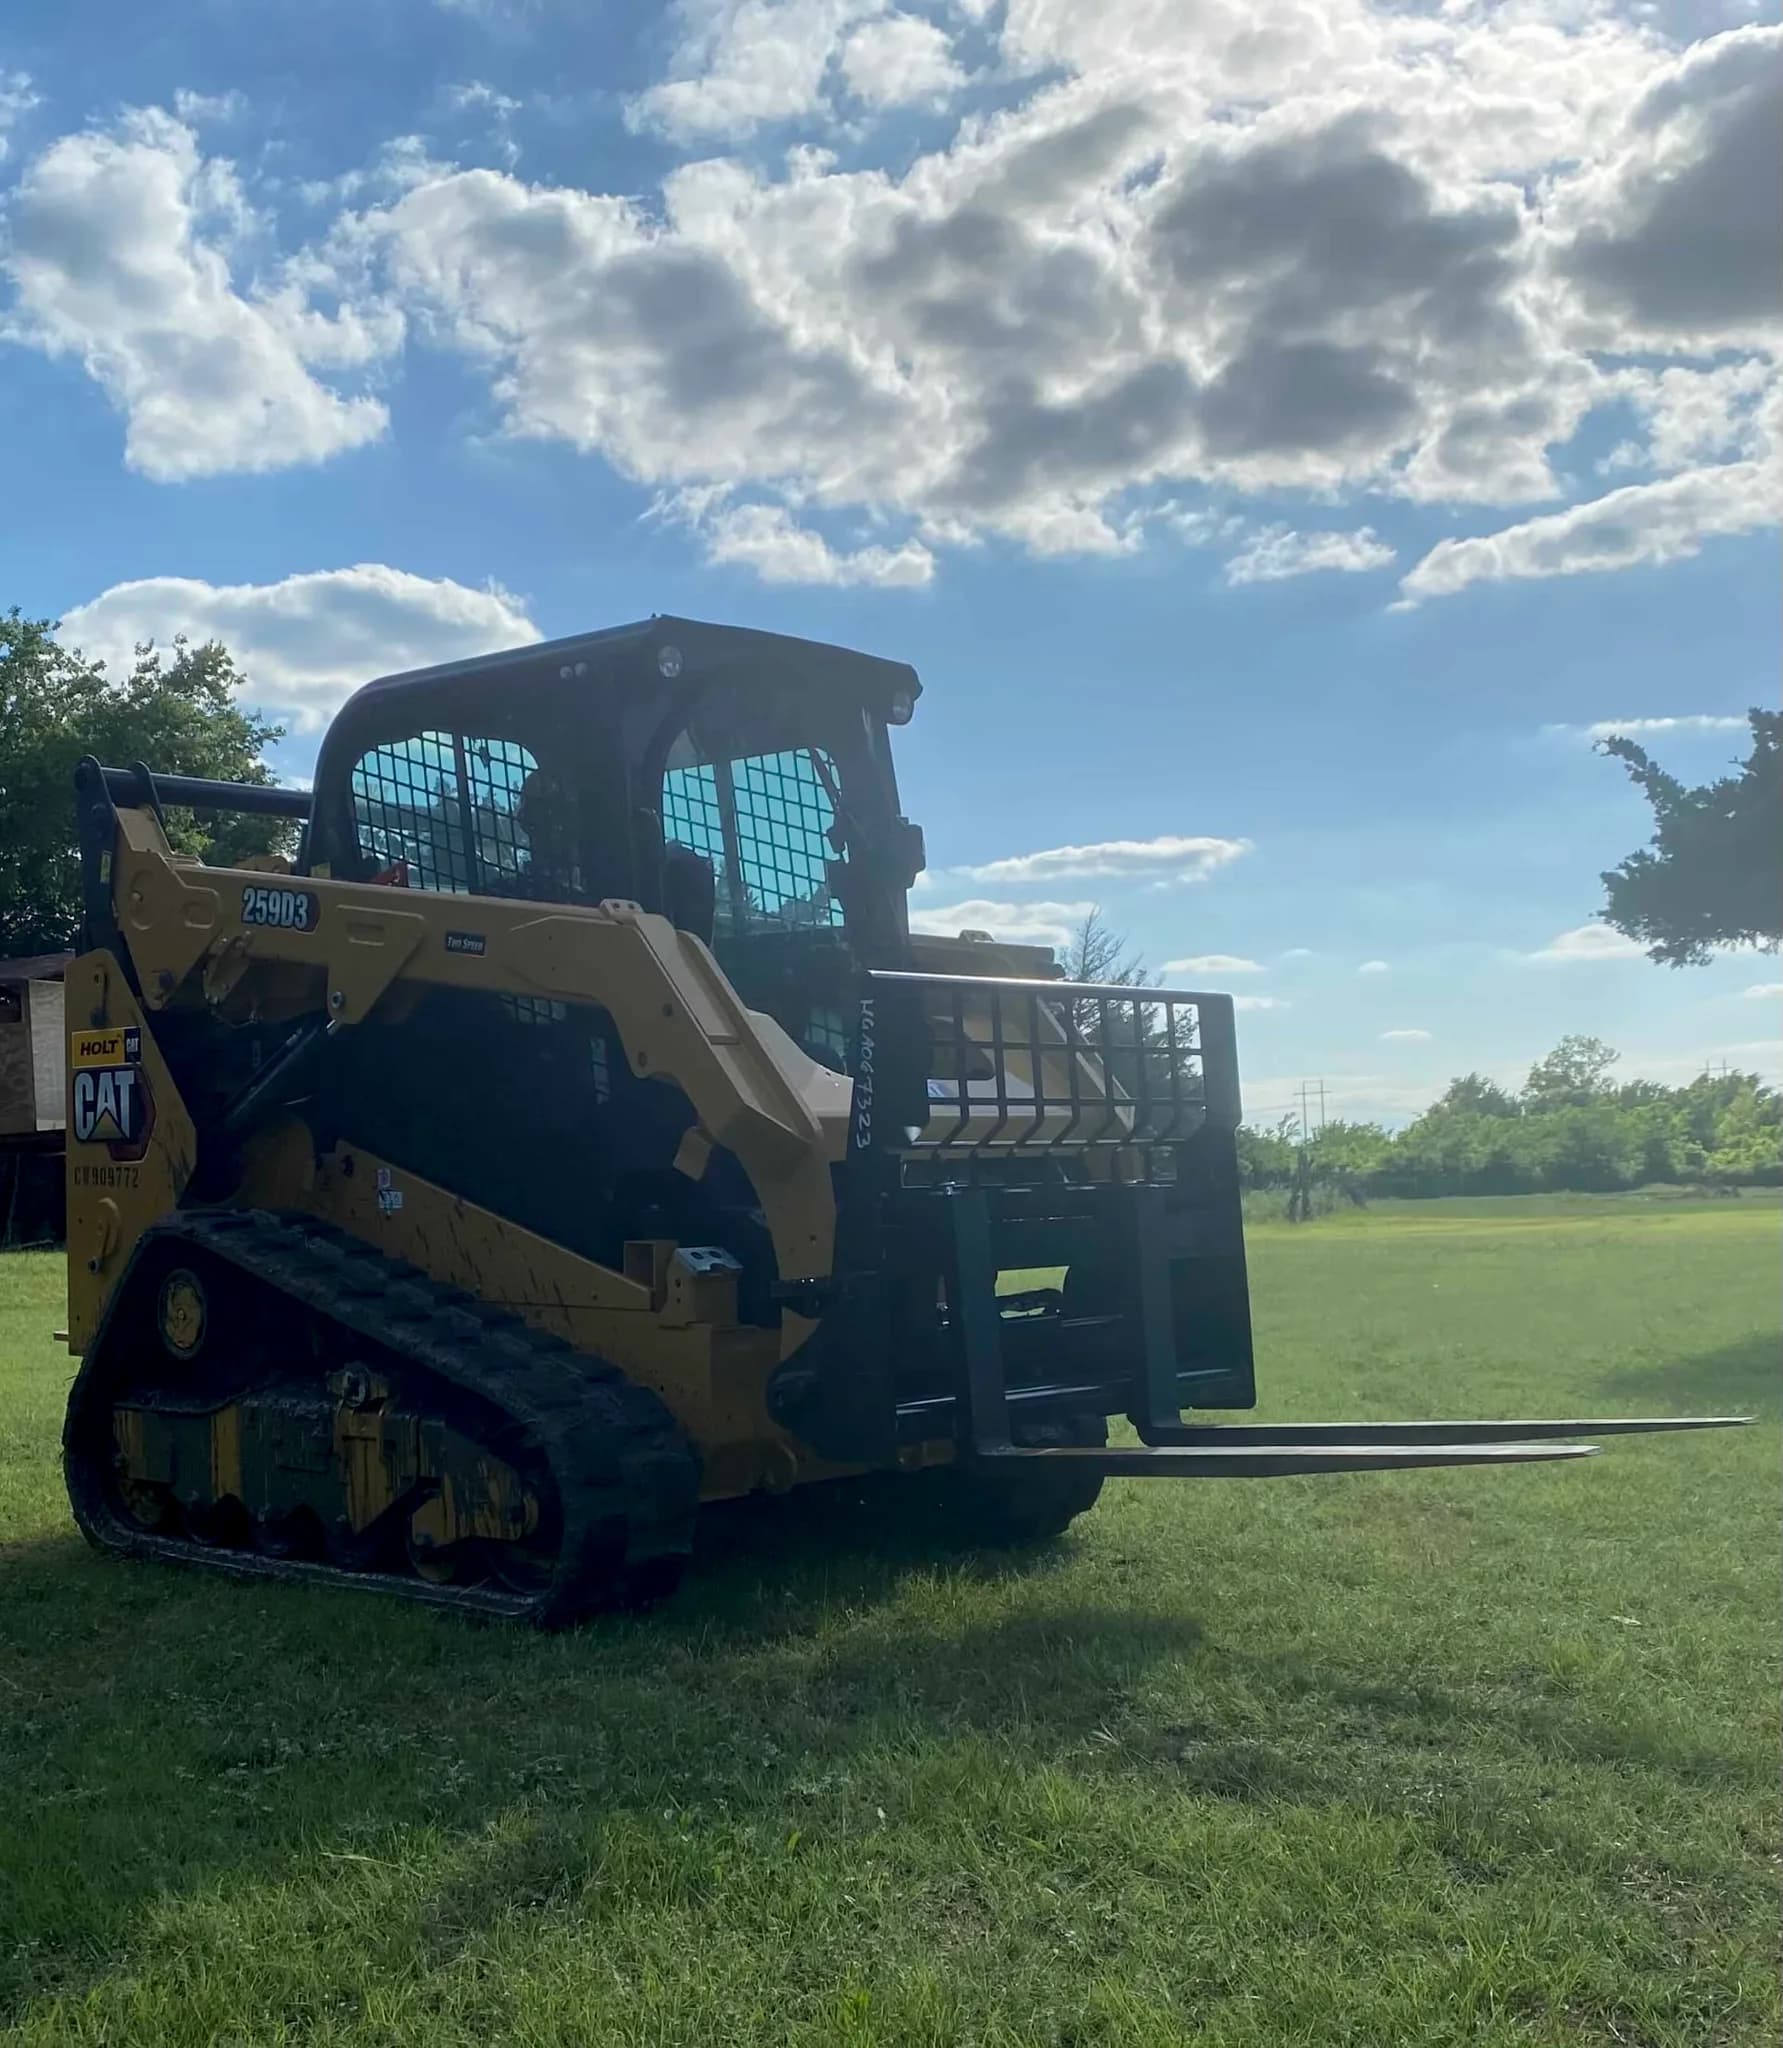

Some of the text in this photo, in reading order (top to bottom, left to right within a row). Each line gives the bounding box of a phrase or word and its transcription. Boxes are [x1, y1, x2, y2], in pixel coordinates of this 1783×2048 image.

[241, 888, 310, 930] 259D3
[80, 1037, 140, 1056] HOLT CAT
[74, 1070, 136, 1141] CAT
